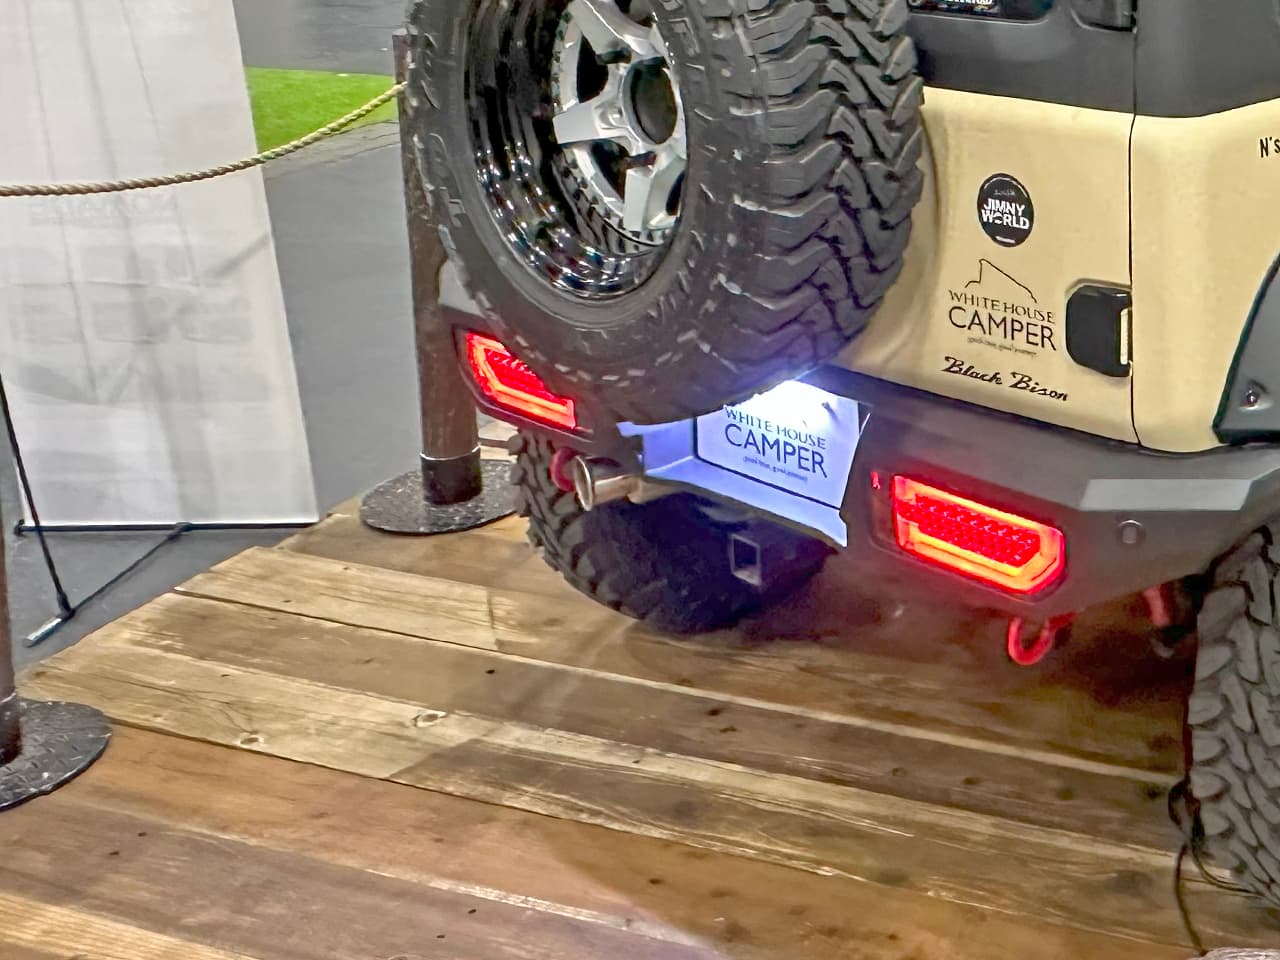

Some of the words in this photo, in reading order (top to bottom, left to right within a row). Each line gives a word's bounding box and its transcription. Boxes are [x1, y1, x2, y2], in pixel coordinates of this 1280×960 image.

[1259, 136, 1280, 158] N's
[981, 209, 1030, 230] WORLD
[983, 197, 1025, 216] JIMNY
[948, 289, 1000, 312] WHITE
[1003, 302, 1056, 325] HOUSE
[948, 306, 1057, 352] CAMPER
[941, 355, 1003, 385] Black
[1009, 371, 1069, 401] Bison
[725, 407, 773, 432] WHITE
[776, 425, 826, 450] HOUSE
[725, 423, 828, 479] CAMPER
